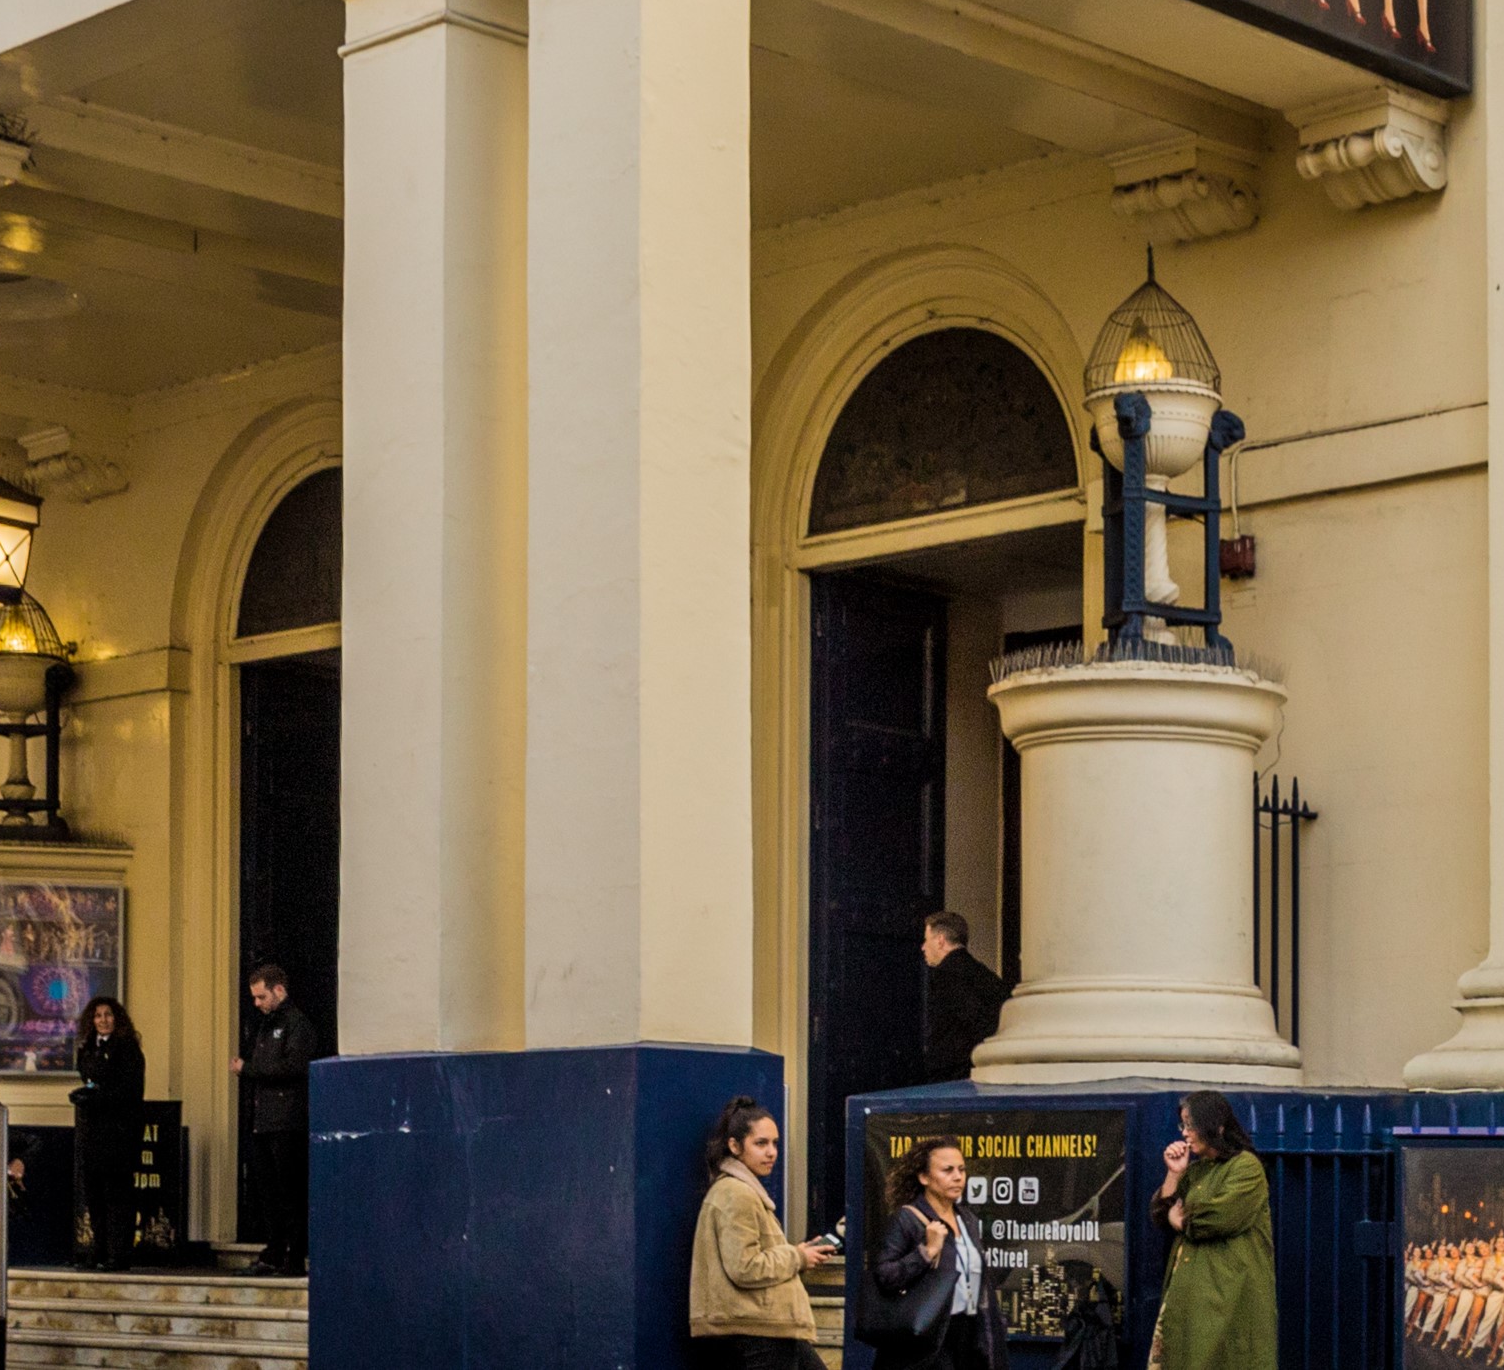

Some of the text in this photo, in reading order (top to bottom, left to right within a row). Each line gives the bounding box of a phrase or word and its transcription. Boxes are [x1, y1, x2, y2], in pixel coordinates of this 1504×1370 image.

[977, 1134, 1022, 1158] SOCIAL
[1026, 1134, 1098, 1158] CHANNELS!
[991, 1218, 1101, 1242] @TheatreRoyalDL
[983, 1246, 1028, 1268] dStreet
